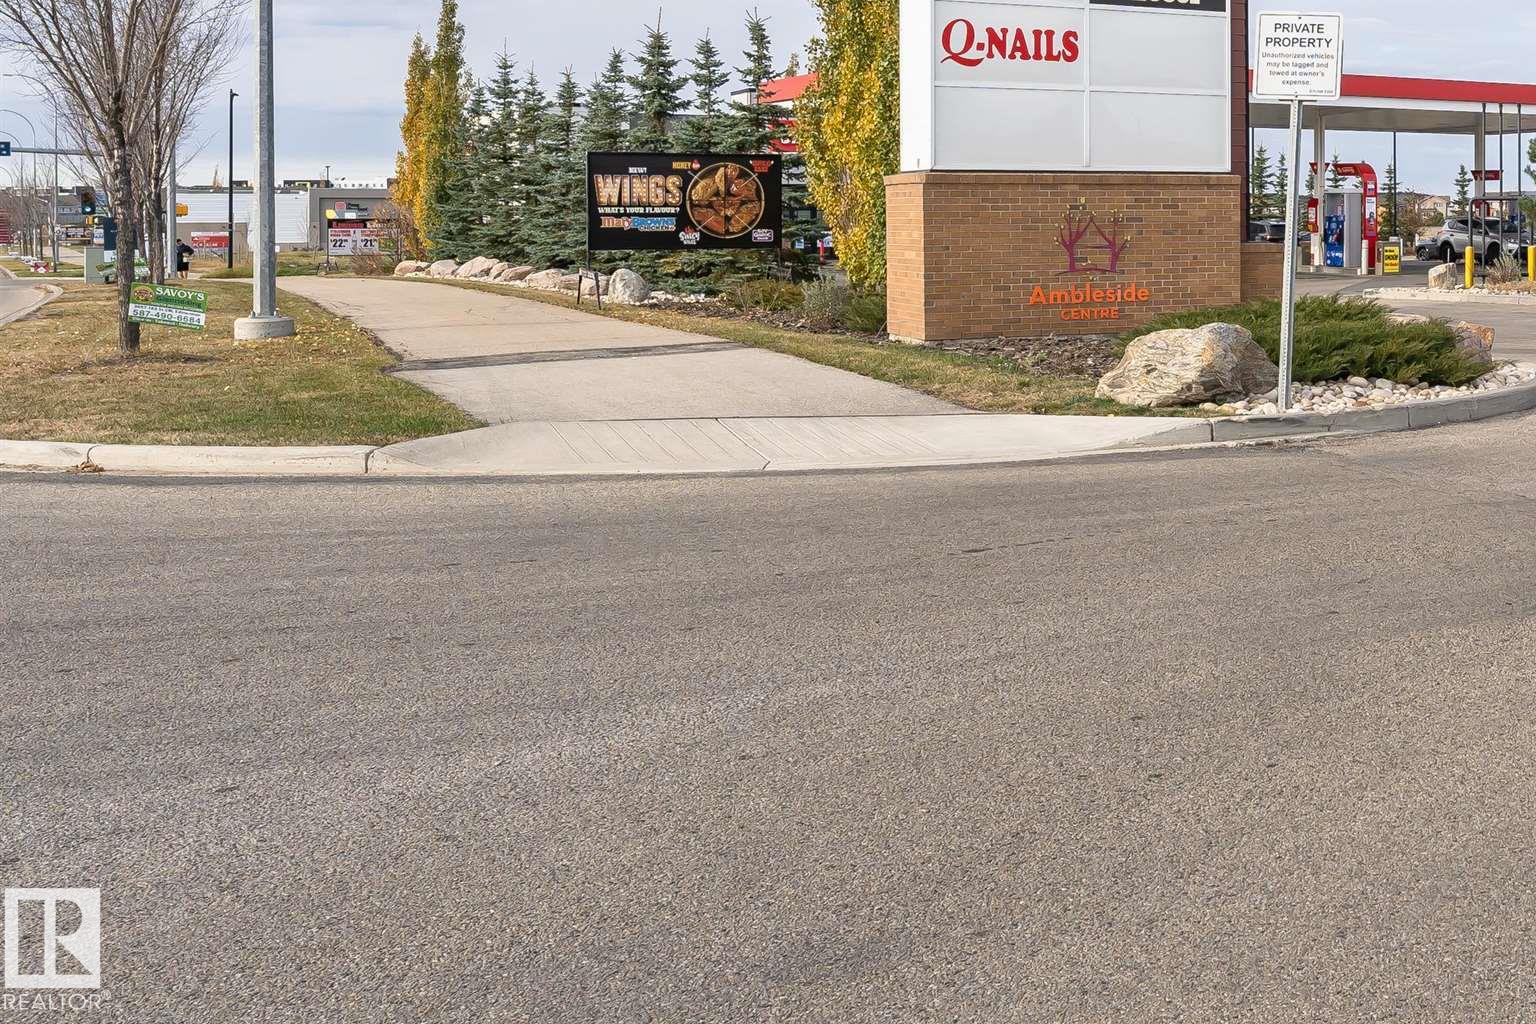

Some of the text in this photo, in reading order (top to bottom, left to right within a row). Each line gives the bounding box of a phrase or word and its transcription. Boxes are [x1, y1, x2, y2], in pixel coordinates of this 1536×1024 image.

[1274, 23, 1325, 34] PRIVATE
[940, 18, 1079, 67] Q-NAILS
[1265, 37, 1332, 48] PROPERTY
[1261, 51, 1335, 60] Unauthorized vehicles
[1291, 61, 1315, 69] tagged
[593, 174, 683, 206] WINGS
[626, 206, 645, 214] YOUR
[645, 206, 680, 214] FLAVOUR?
[155, 287, 205, 301] SAVOY'S
[1029, 283, 1150, 305] Ambleside
[1060, 307, 1120, 321] CENTRE
